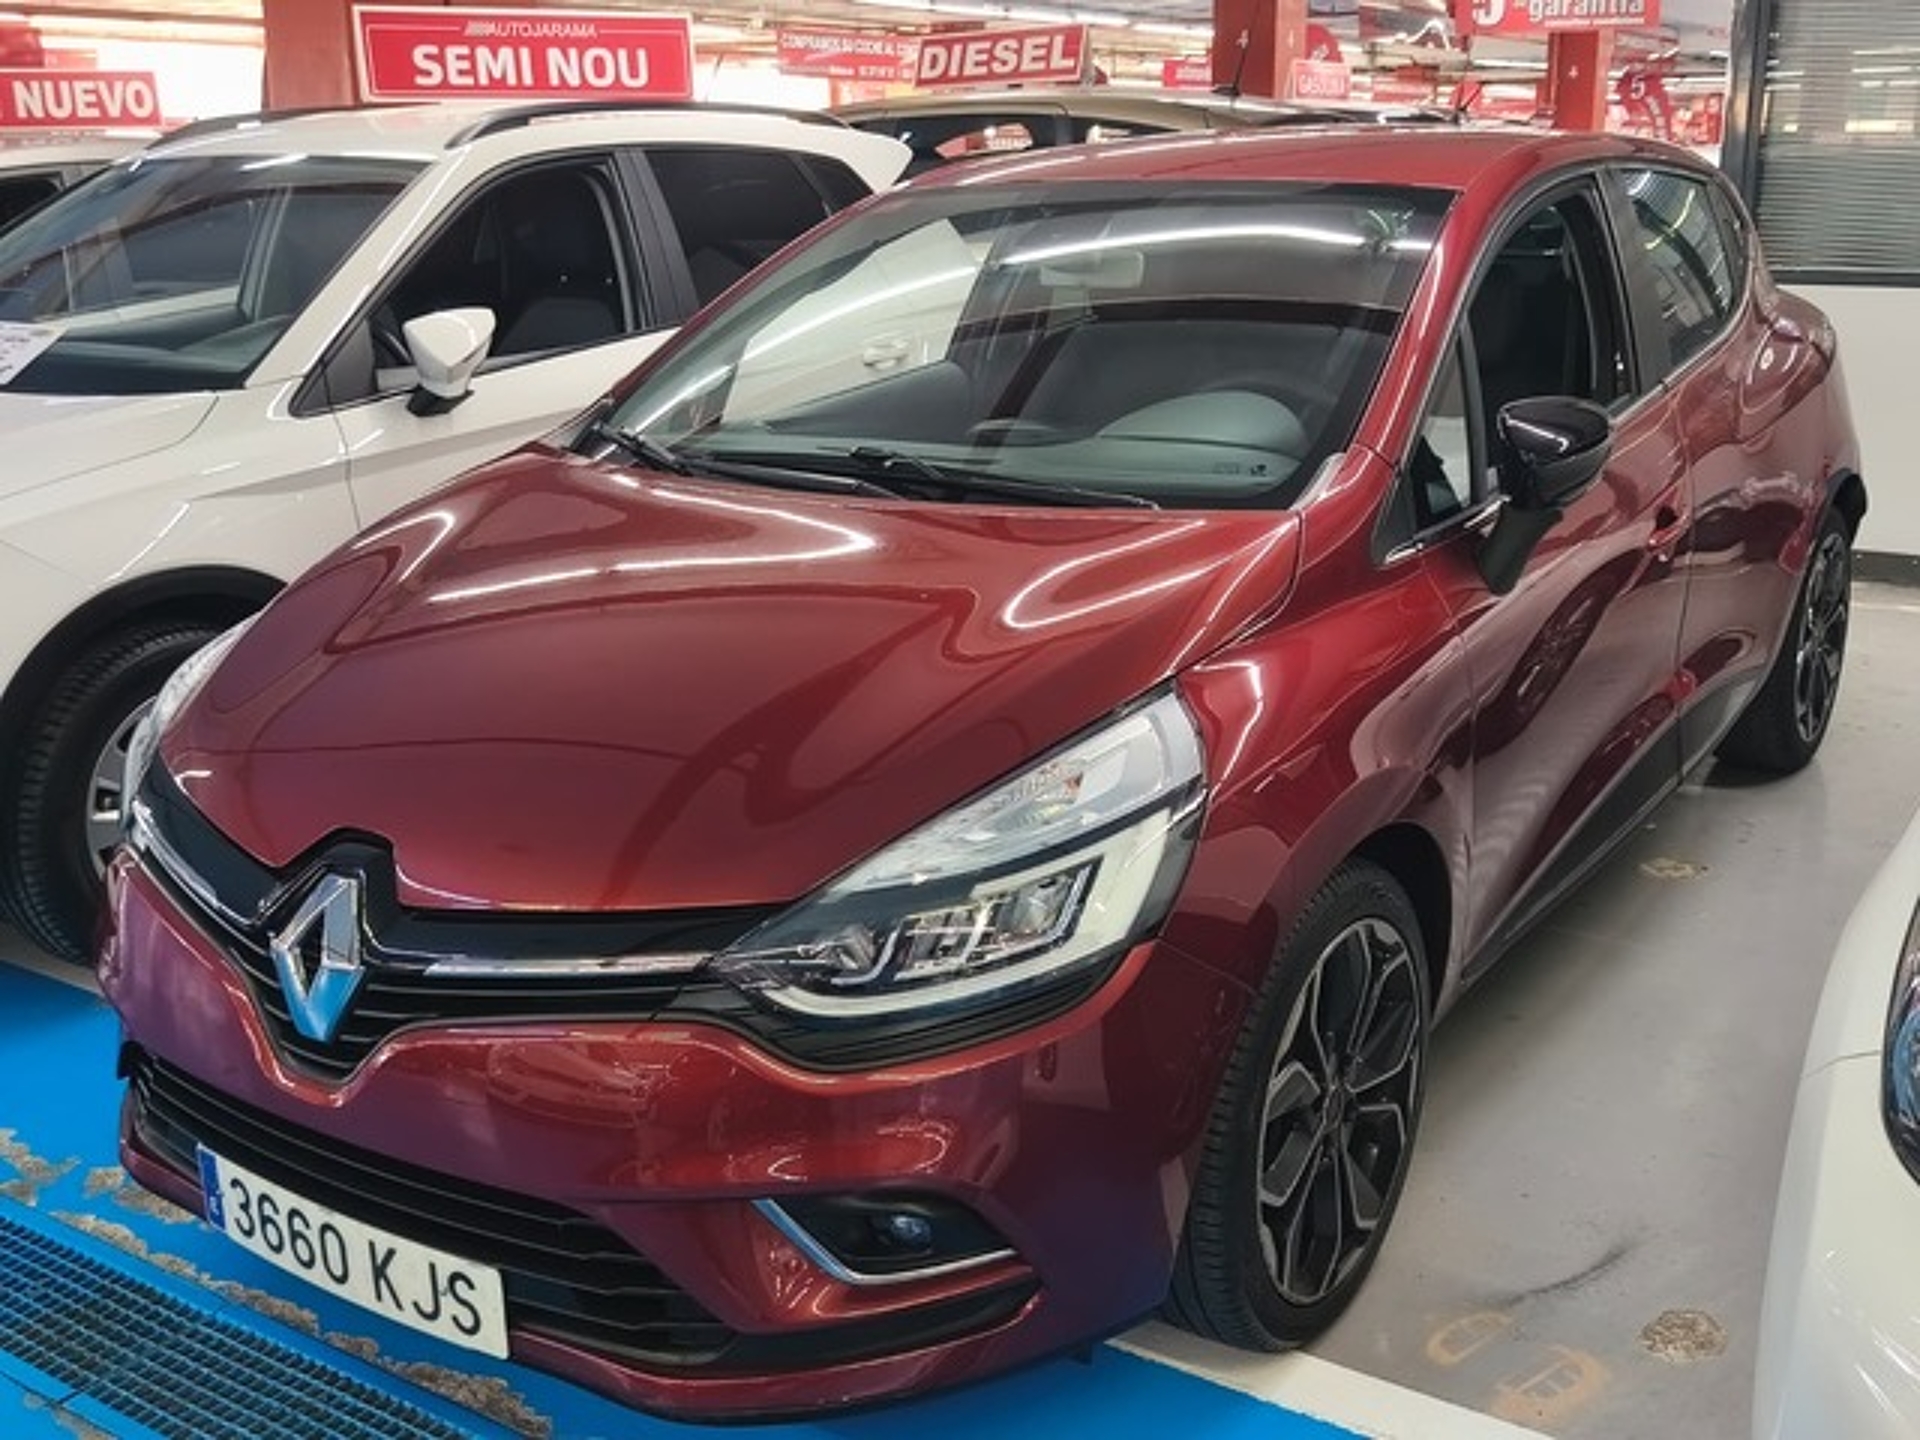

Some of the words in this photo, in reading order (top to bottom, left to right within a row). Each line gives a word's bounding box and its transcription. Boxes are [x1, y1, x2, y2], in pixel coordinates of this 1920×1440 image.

[412, 44, 533, 87] SEMI
[546, 47, 649, 88] NOU
[920, 35, 1075, 79] DIESEL
[12, 80, 154, 118] NUEVO
[230, 1178, 349, 1285] 3660
[368, 1240, 481, 1336] KJS
